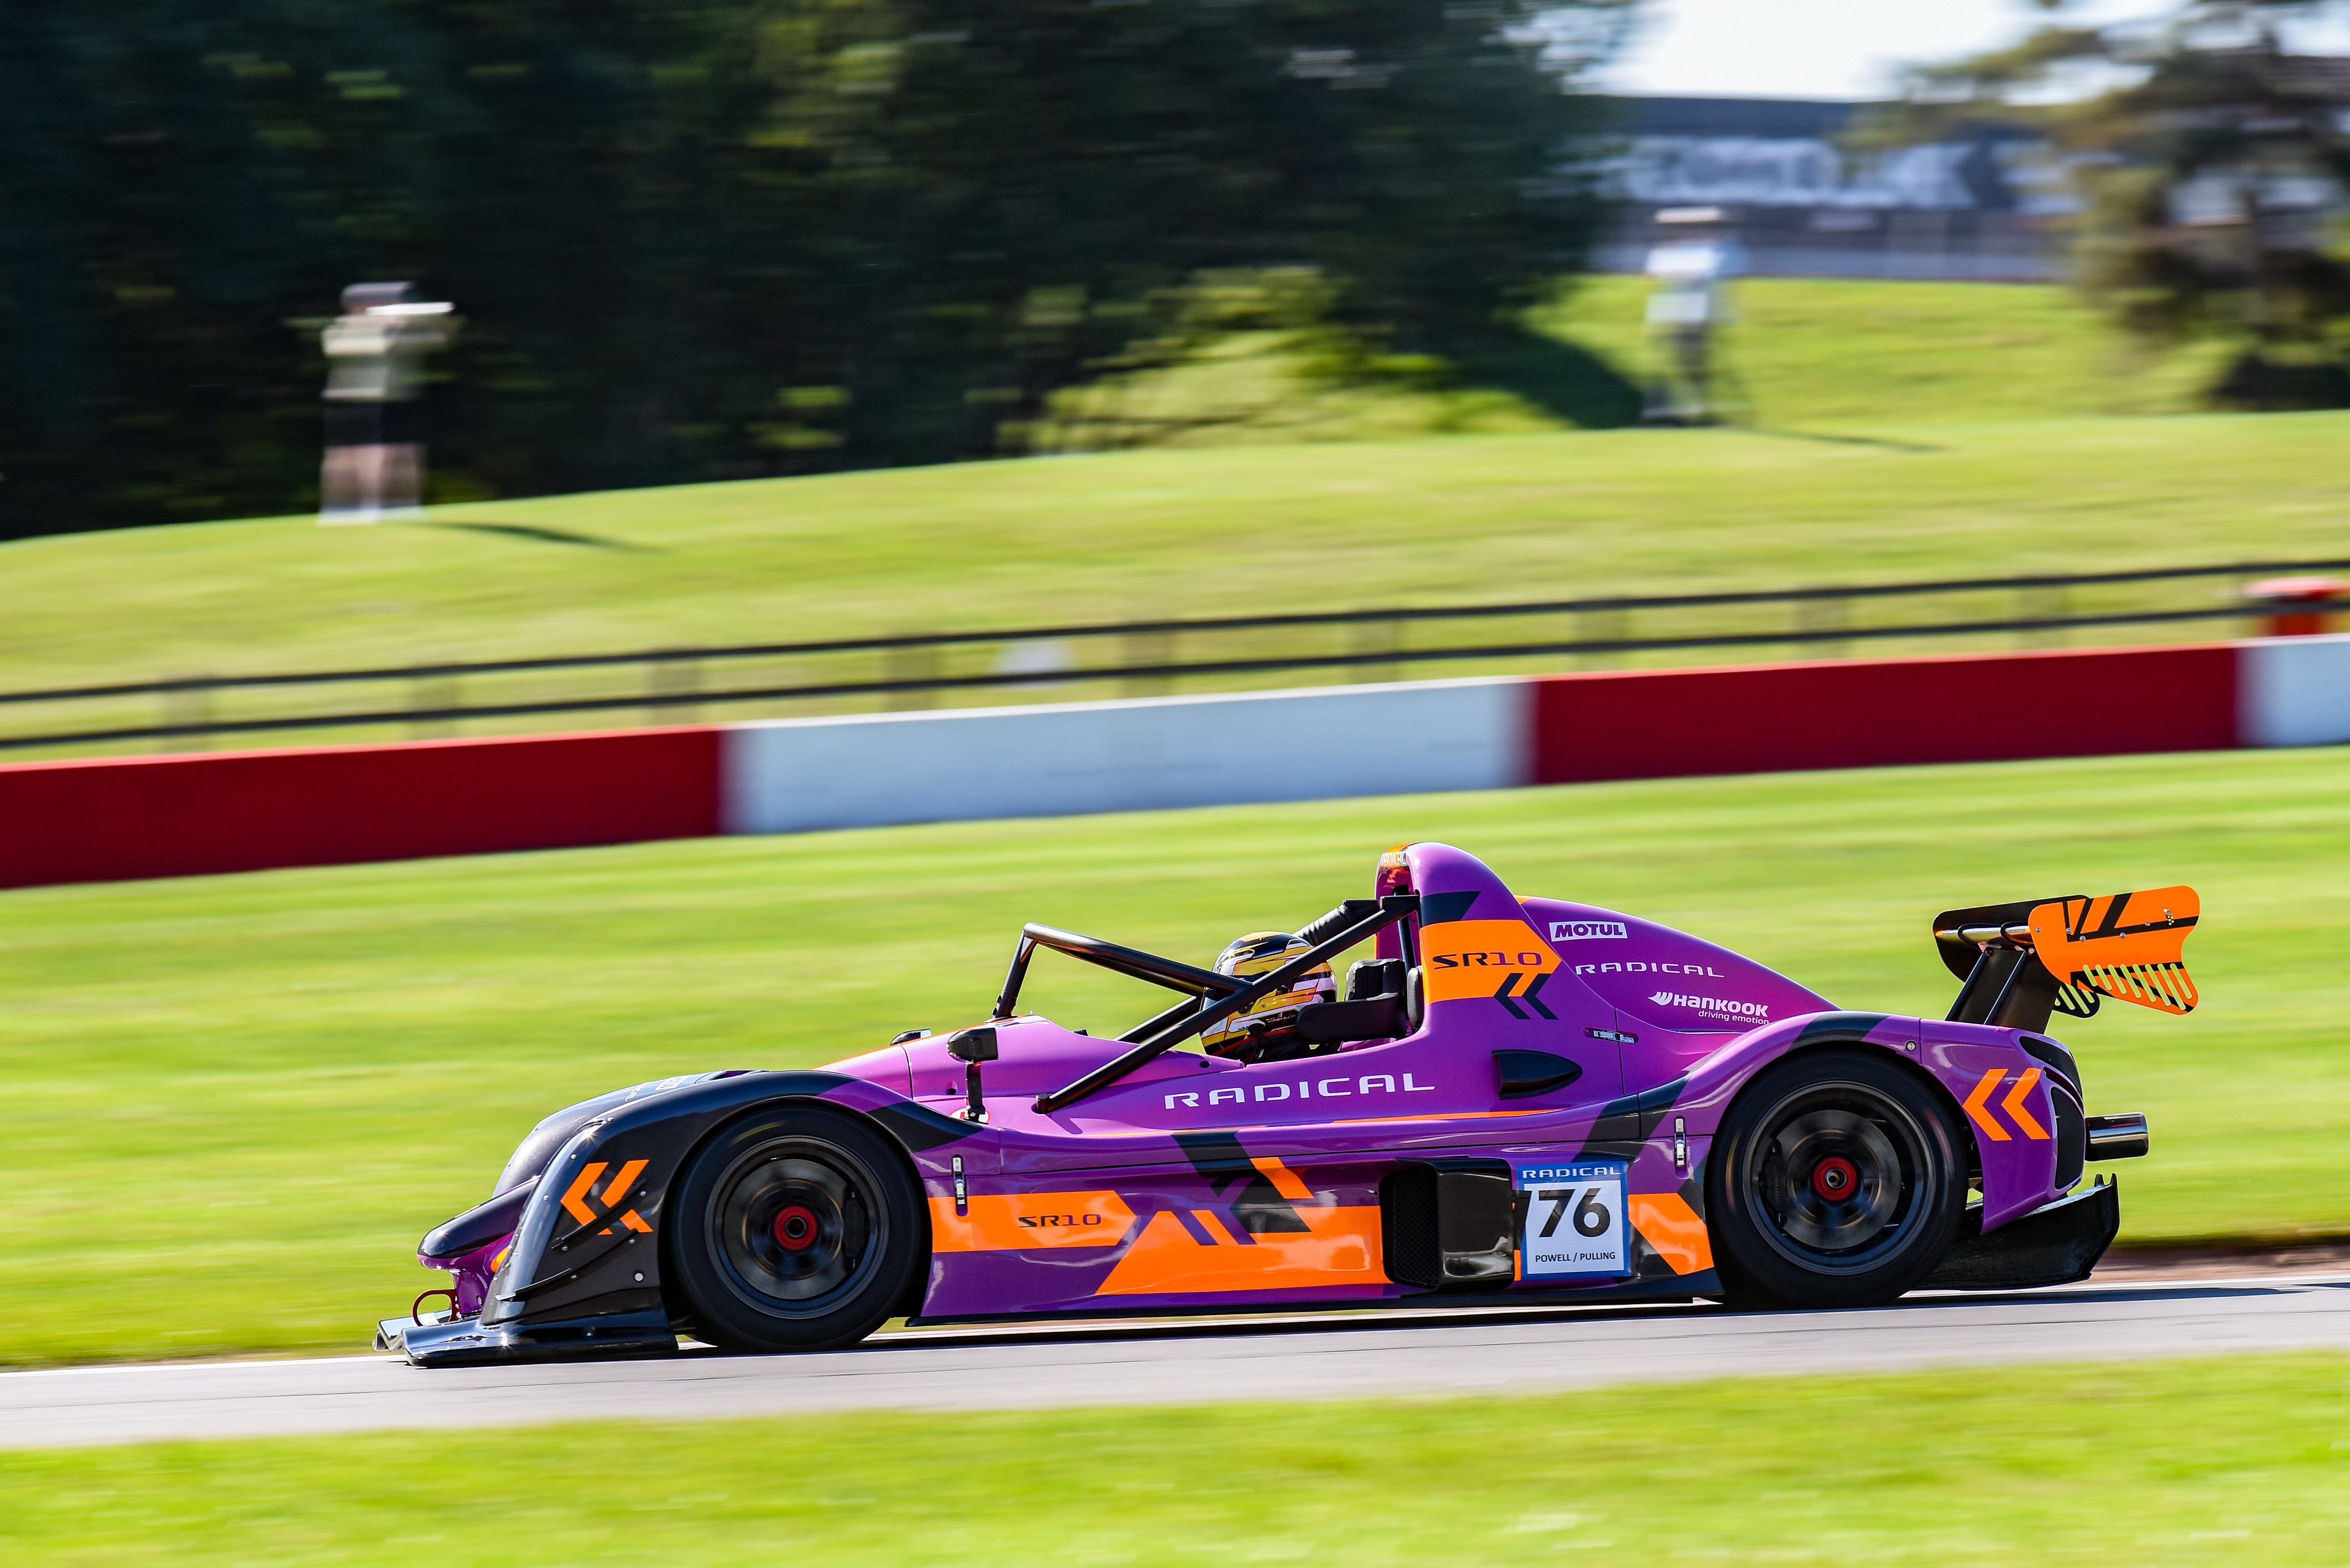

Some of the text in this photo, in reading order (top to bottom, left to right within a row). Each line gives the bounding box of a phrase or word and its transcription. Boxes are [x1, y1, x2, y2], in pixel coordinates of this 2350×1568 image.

[1380, 852, 1407, 867] RADICAL
[1555, 924, 1623, 938] MOTUL
[1433, 952, 1542, 970] SR10
[1575, 962, 1725, 978] RADICAL
[1698, 1010, 1769, 1025] driving emotion
[1164, 1073, 1435, 1109] RADICAL
[1523, 1167, 1622, 1179] RADICAL
[1538, 1188, 1611, 1238] 76
[1018, 1214, 1102, 1228] SR10
[1535, 1252, 1616, 1263] POWELL / PULLING
